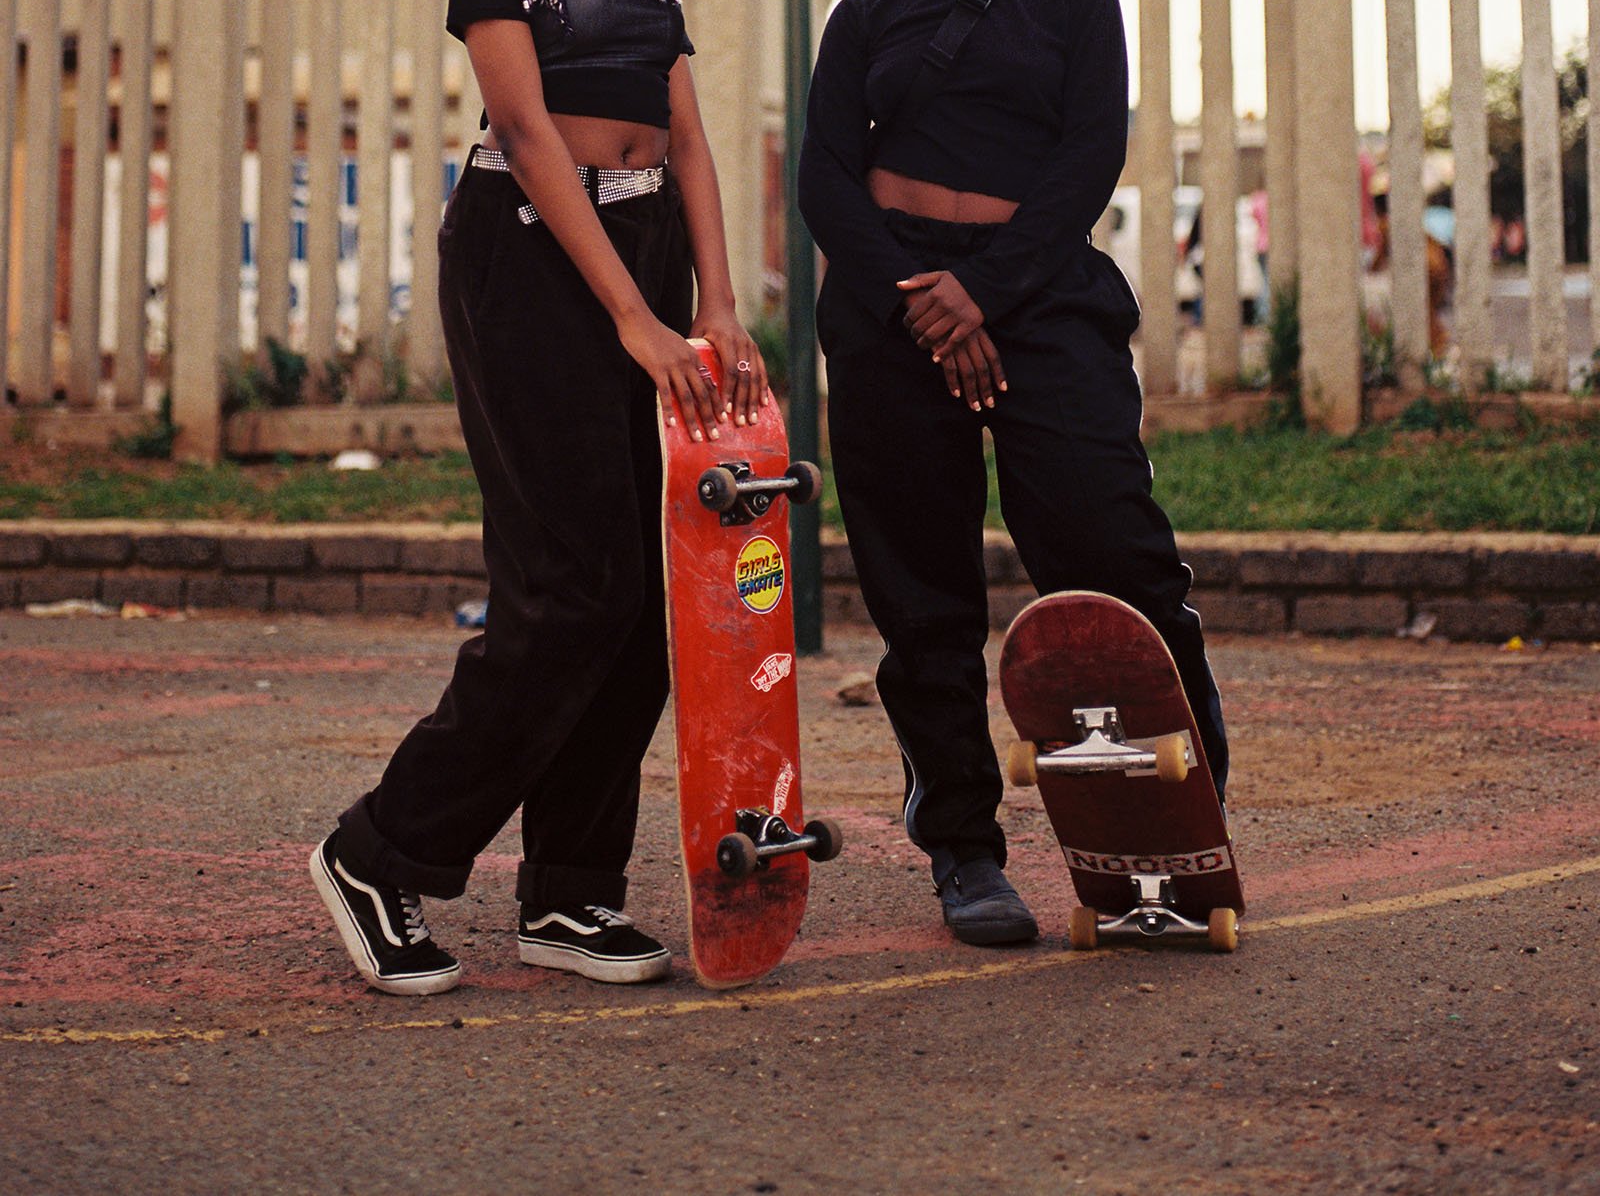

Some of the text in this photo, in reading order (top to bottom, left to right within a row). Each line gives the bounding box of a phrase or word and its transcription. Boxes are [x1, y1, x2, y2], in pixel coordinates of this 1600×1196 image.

[737, 552, 781, 580] GIRLS
[738, 569, 783, 597] SKATE
[1070, 851, 1223, 874] NOORD
